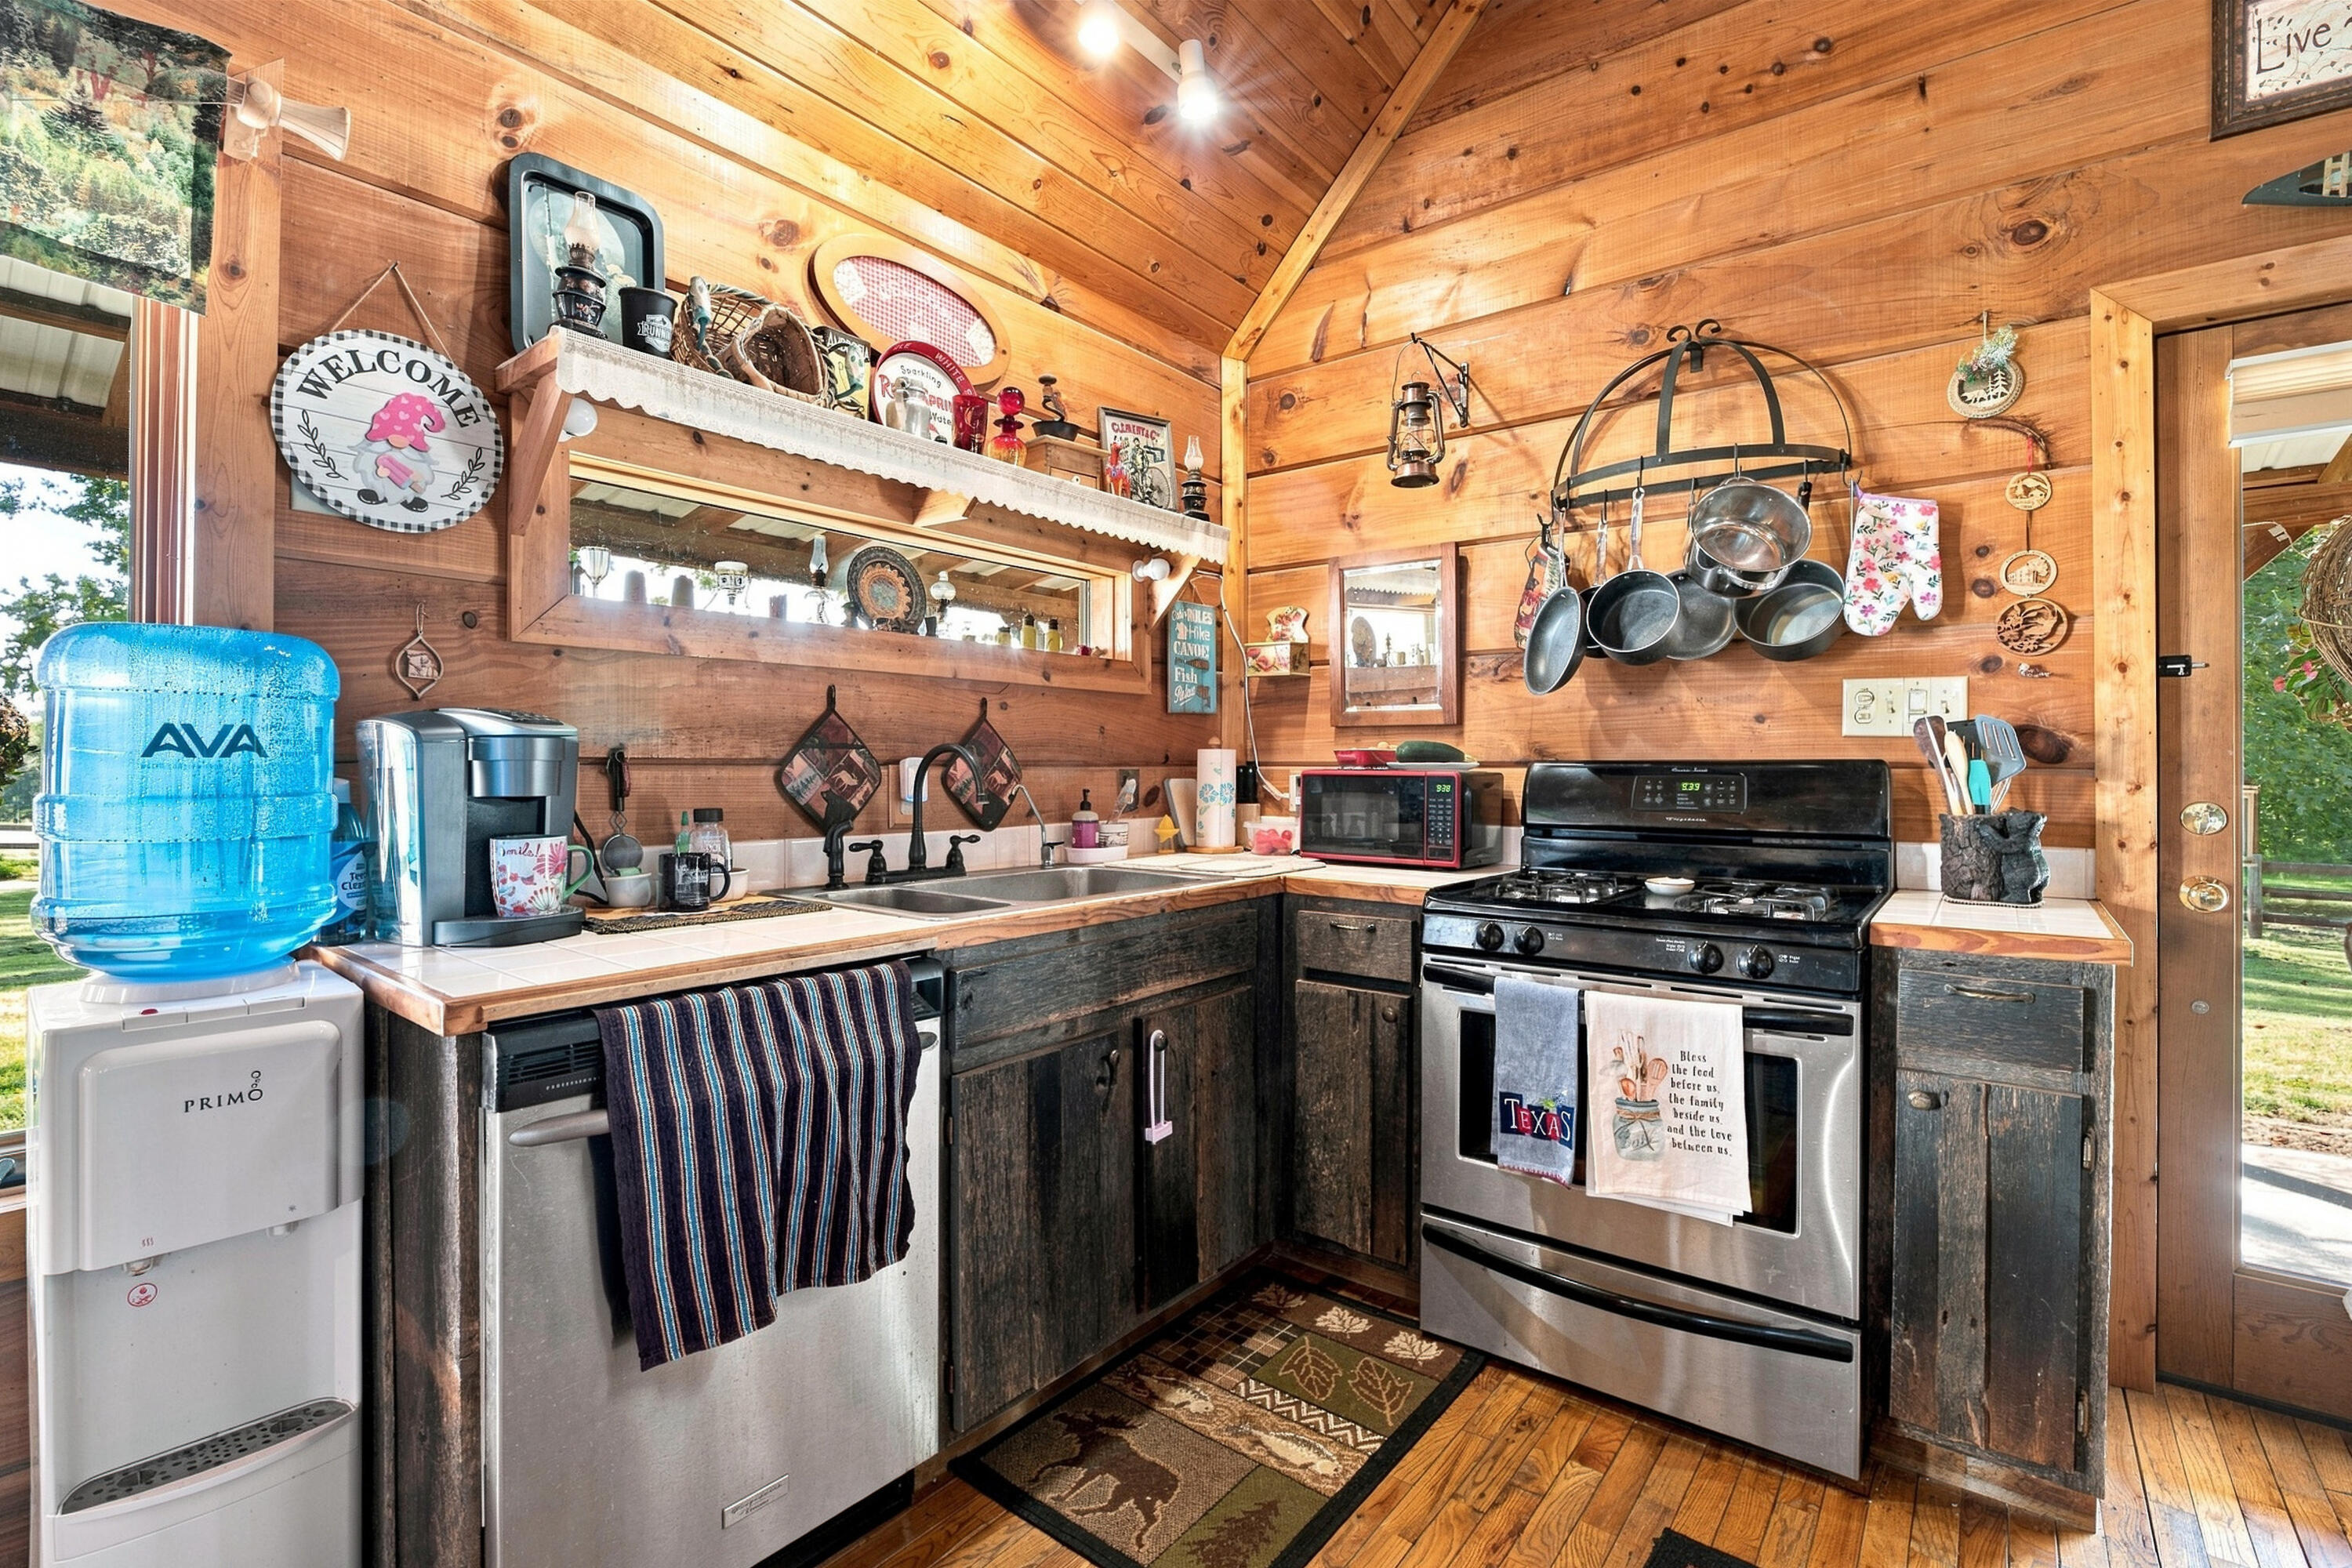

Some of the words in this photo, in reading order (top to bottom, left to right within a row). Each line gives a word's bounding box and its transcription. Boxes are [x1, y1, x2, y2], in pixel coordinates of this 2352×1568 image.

[2256, 18, 2332, 75] Live
[935, 352, 965, 383] WHITE
[900, 365, 942, 389] Sparkling
[296, 349, 481, 428] WELCOME
[930, 411, 952, 426] Wate
[1187, 608, 1213, 626] RULES
[1189, 624, 1210, 641] Hike
[1173, 641, 1210, 659] CANOE
[1174, 666, 1198, 684] Fish
[140, 722, 270, 759] AVA
[1680, 1050, 1707, 1062] Bless
[1671, 1063, 1688, 1075] the
[1693, 1065, 1715, 1078] food
[1671, 1076, 1701, 1091] before
[184, 1088, 263, 1113] PRIMO
[1668, 1093, 1685, 1105] the
[1690, 1095, 1724, 1112] family
[1504, 1098, 1571, 1142] TEXAS
[1672, 1107, 1704, 1122] beside
[1667, 1123, 1684, 1135] and
[1690, 1125, 1706, 1138] the
[1711, 1127, 1733, 1142] love
[1671, 1137, 1713, 1152] between
